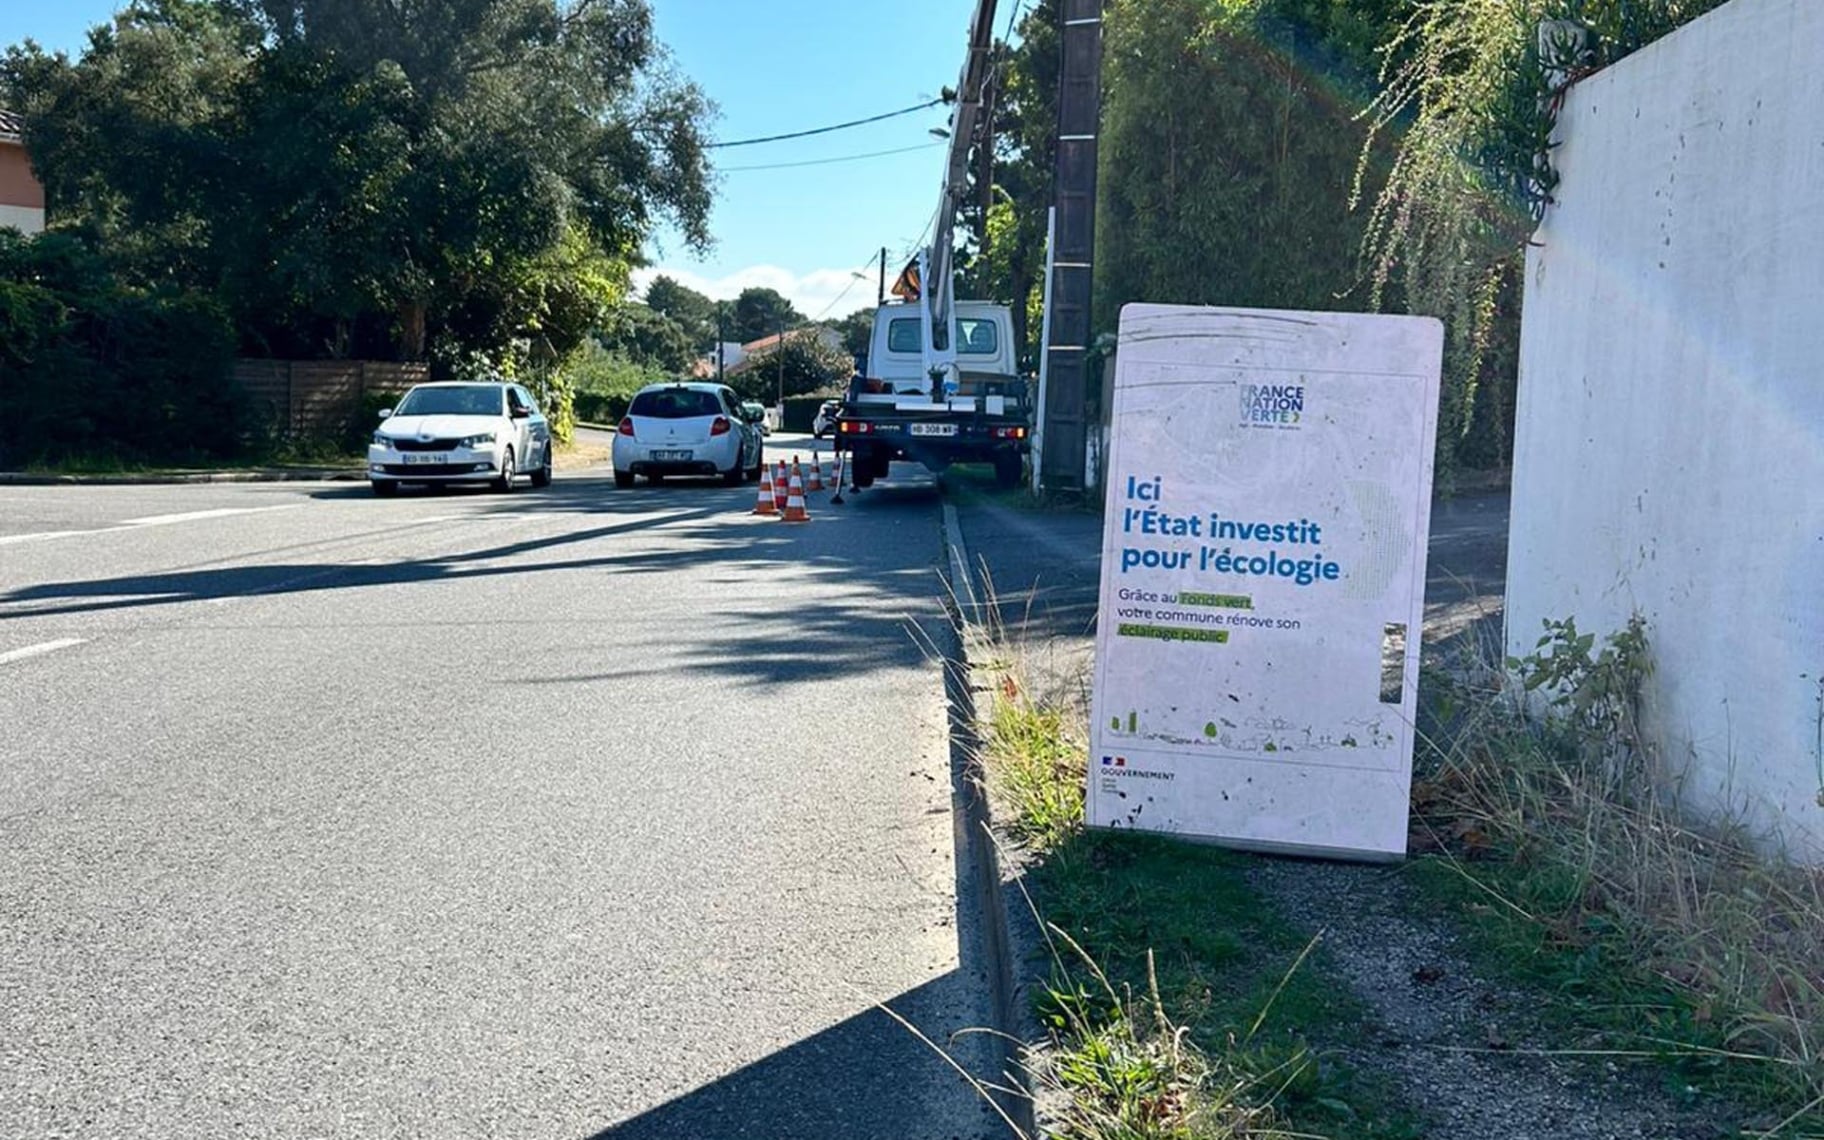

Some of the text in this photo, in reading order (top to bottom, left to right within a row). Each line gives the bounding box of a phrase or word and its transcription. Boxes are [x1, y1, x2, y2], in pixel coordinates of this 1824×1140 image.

[1240, 384, 1304, 399] FRANCE
[1240, 397, 1303, 411] NATION
[1241, 408, 1289, 423] VERTE
[1126, 476, 1161, 501] Ici
[1124, 505, 1321, 544] l'État investit
[1121, 546, 1340, 585] pour l'écologie
[1118, 588, 1158, 602] Grâce
[1161, 593, 1178, 604] au
[1117, 607, 1301, 629] votre commune rénove son
[1100, 767, 1175, 780] GOUVERNEMENT
